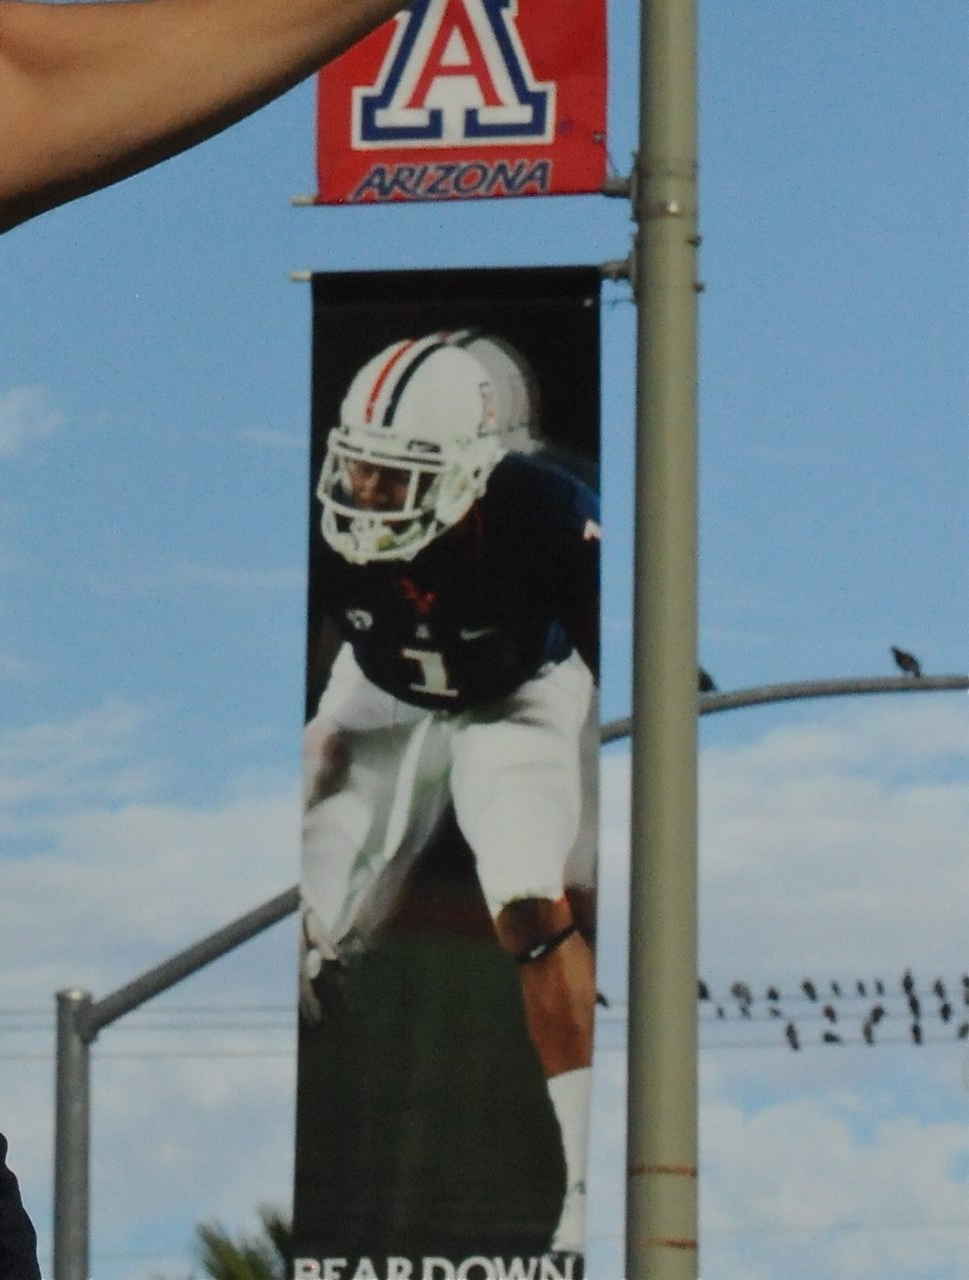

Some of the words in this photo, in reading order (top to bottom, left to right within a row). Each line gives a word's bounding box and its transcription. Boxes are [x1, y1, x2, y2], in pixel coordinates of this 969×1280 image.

[351, 160, 552, 200] ARIZONA
[402, 649, 458, 696] 1
[293, 1256, 413, 1280] BEAR
[422, 1255, 576, 1280] DOWN
